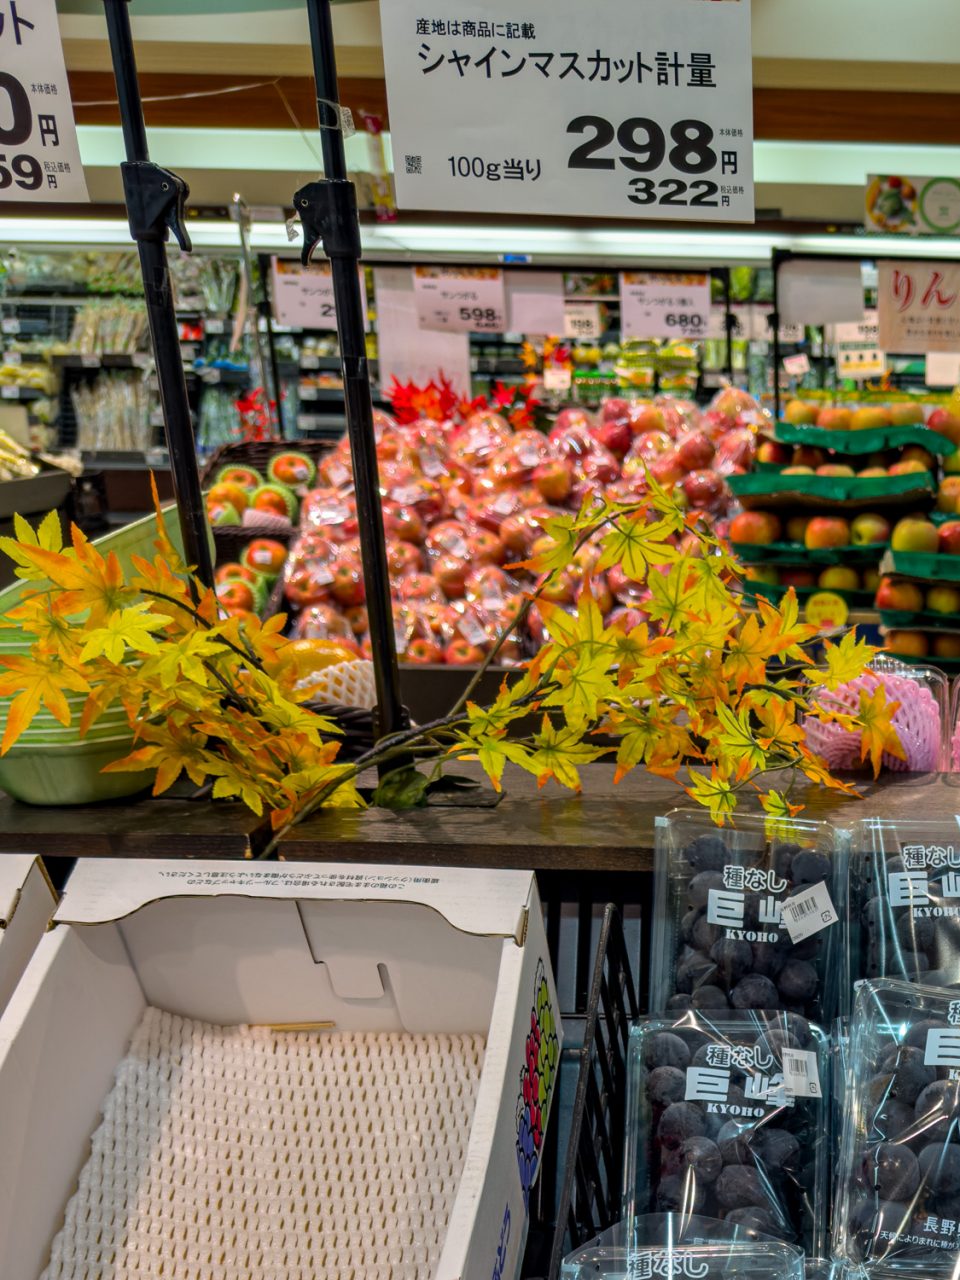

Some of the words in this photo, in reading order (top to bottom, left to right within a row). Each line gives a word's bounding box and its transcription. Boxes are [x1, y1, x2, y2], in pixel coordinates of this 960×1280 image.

[0, 1, 35, 45] ト
[415, 18, 536, 40] 産地は商品に記載
[417, 43, 717, 88] シャインマスカット計量
[38, 114, 59, 146] 円
[566, 115, 718, 174] 298
[721, 151, 738, 175] 円
[448, 156, 541, 181] 100g当り
[627, 178, 719, 207] 322
[459, 307, 496, 321] 598
[665, 313, 702, 328] 680
[722, 864, 788, 893] 種なし
[724, 928, 779, 943] KYOHO
[705, 1045, 774, 1069] 種なし
[705, 1102, 766, 1119] KYOHO
[627, 1251, 709, 1280] 種なし
